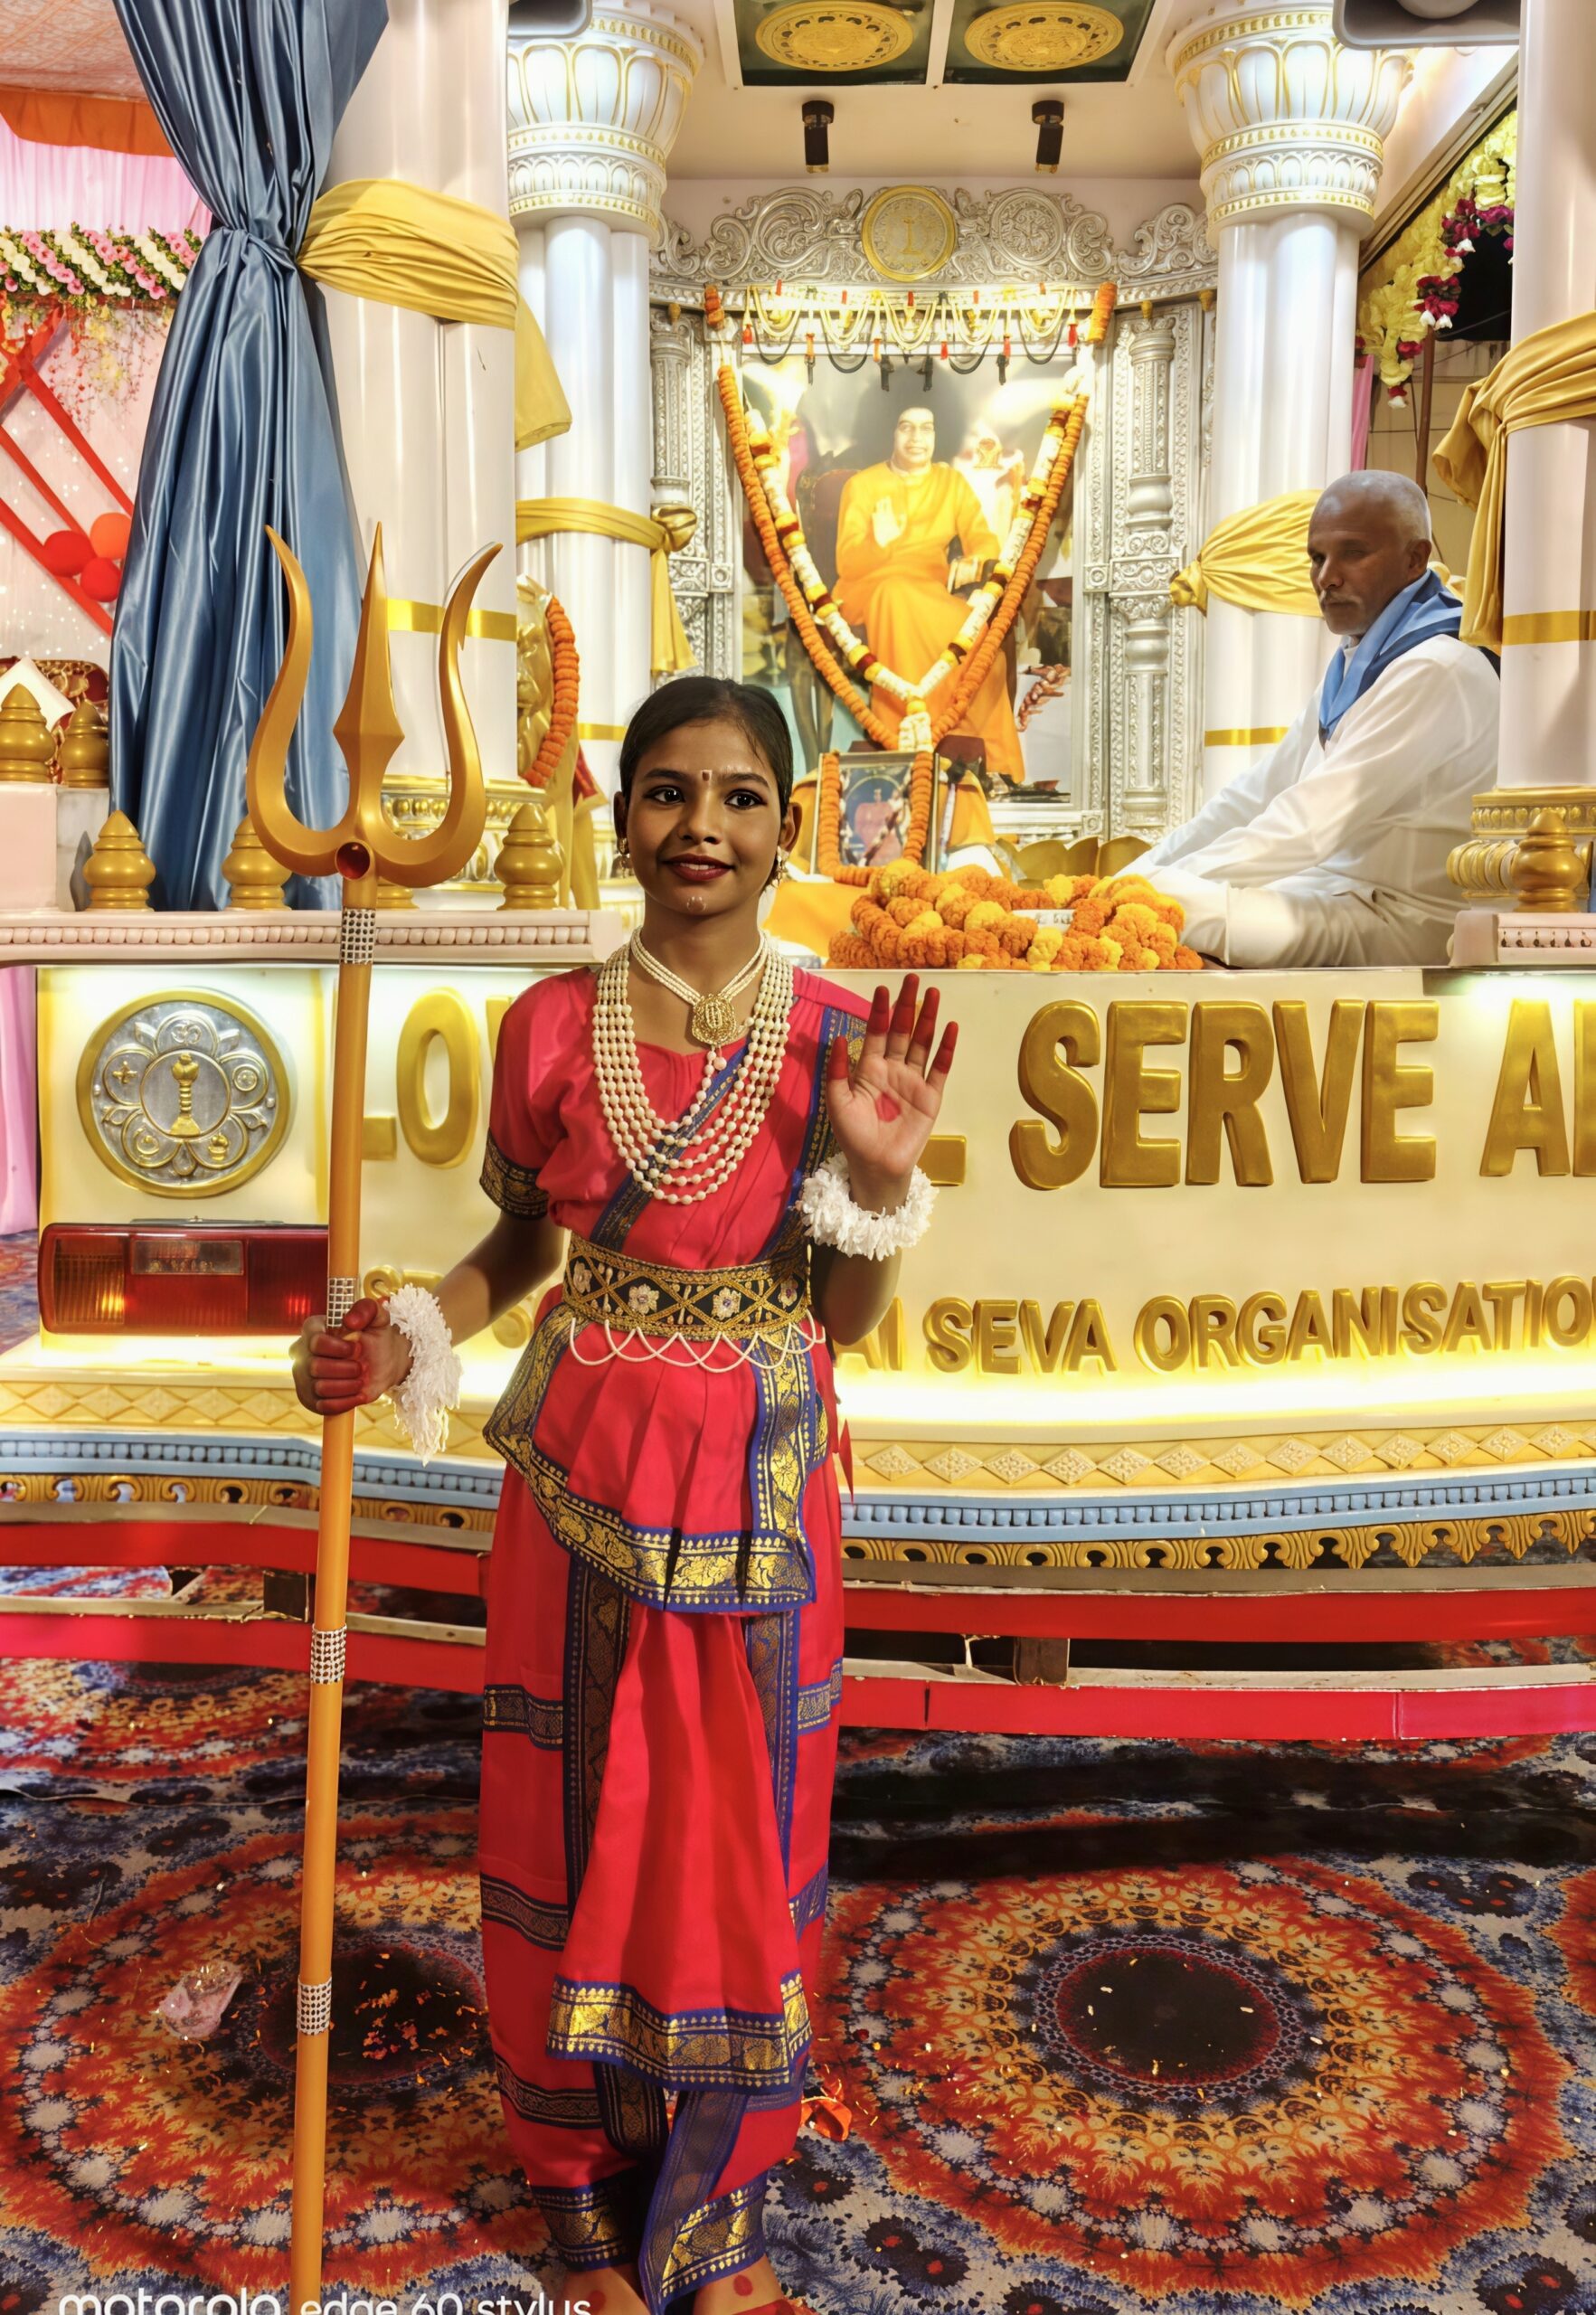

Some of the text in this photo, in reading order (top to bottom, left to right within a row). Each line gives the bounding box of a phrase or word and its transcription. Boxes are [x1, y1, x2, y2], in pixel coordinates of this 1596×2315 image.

[1009, 999, 1440, 1191] SERVE
[922, 1296, 1119, 1375] SEVA
[1134, 1275, 1596, 1373] ORGANISATIO
